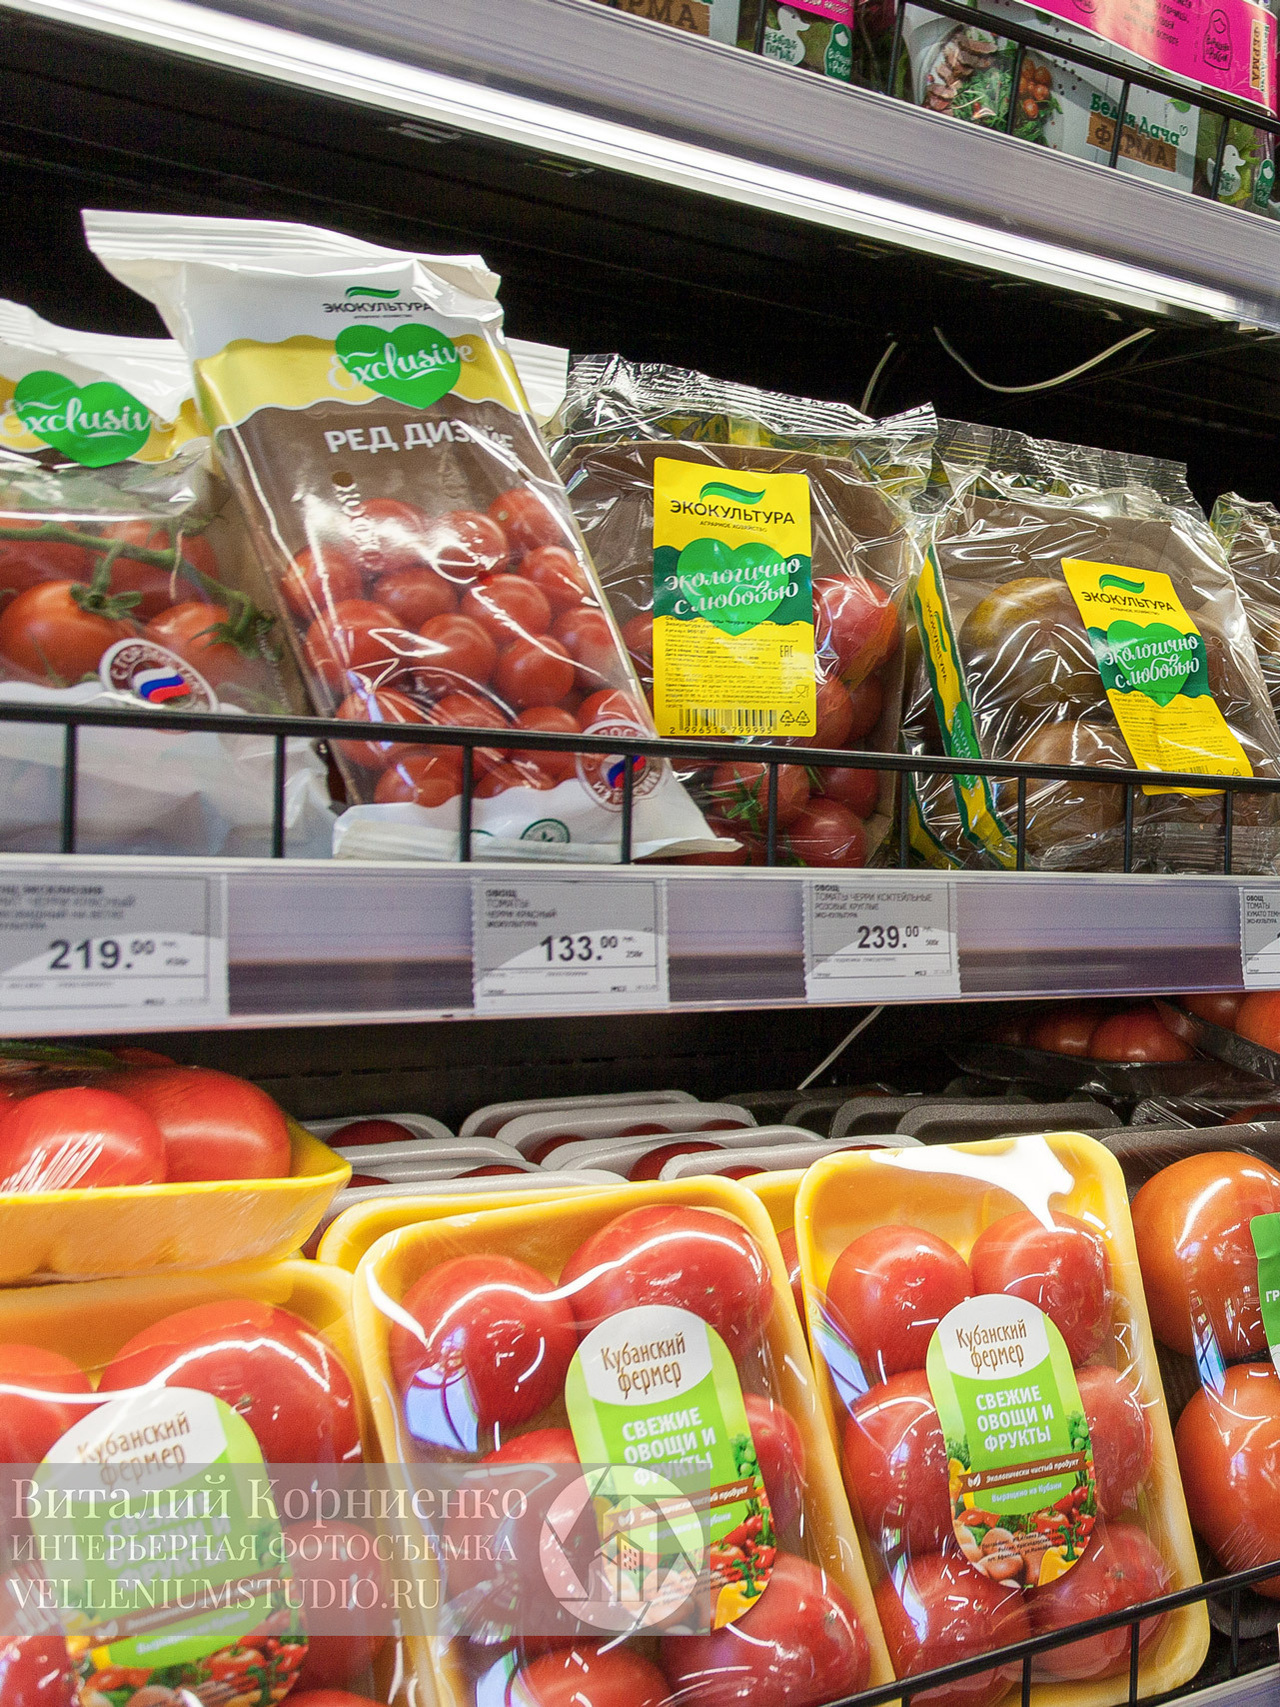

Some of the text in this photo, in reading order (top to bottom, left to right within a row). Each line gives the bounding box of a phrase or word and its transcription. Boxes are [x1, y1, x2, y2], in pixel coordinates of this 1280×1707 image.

[1090, 92, 1181, 147] Беля Дача
[1094, 125, 1170, 167] ФРМА
[322, 302, 434, 314] ЭКОКУЛЬТУРА
[327, 342, 478, 391] Exclusive
[0, 397, 177, 438] Exclusive
[323, 426, 400, 455] РЕД
[670, 499, 796, 526] ЭКОКУЛЬТУРА
[1081, 591, 1177, 613] ЭКОКУЛЬТУРА
[1246, 902, 1271, 910] ТОМАТЫ
[600, 1331, 687, 1375] Кубанский
[956, 1319, 1028, 1350] Кубанский
[970, 1343, 1025, 1375] фермер
[617, 1359, 683, 1400] фермер
[975, 1384, 1042, 1411] СВЕЖИЕ
[621, 1406, 703, 1443] СВЕЖИЕ
[977, 1403, 1055, 1434] ОВОЩИ И
[76, 1410, 191, 1466] Кубанский
[623, 1426, 718, 1467] ОВОЩИ И
[984, 1424, 1052, 1453] ФРУКТЫ
[100, 1442, 187, 1490] фермер
[633, 1451, 715, 1489] ФРУКТЫ
